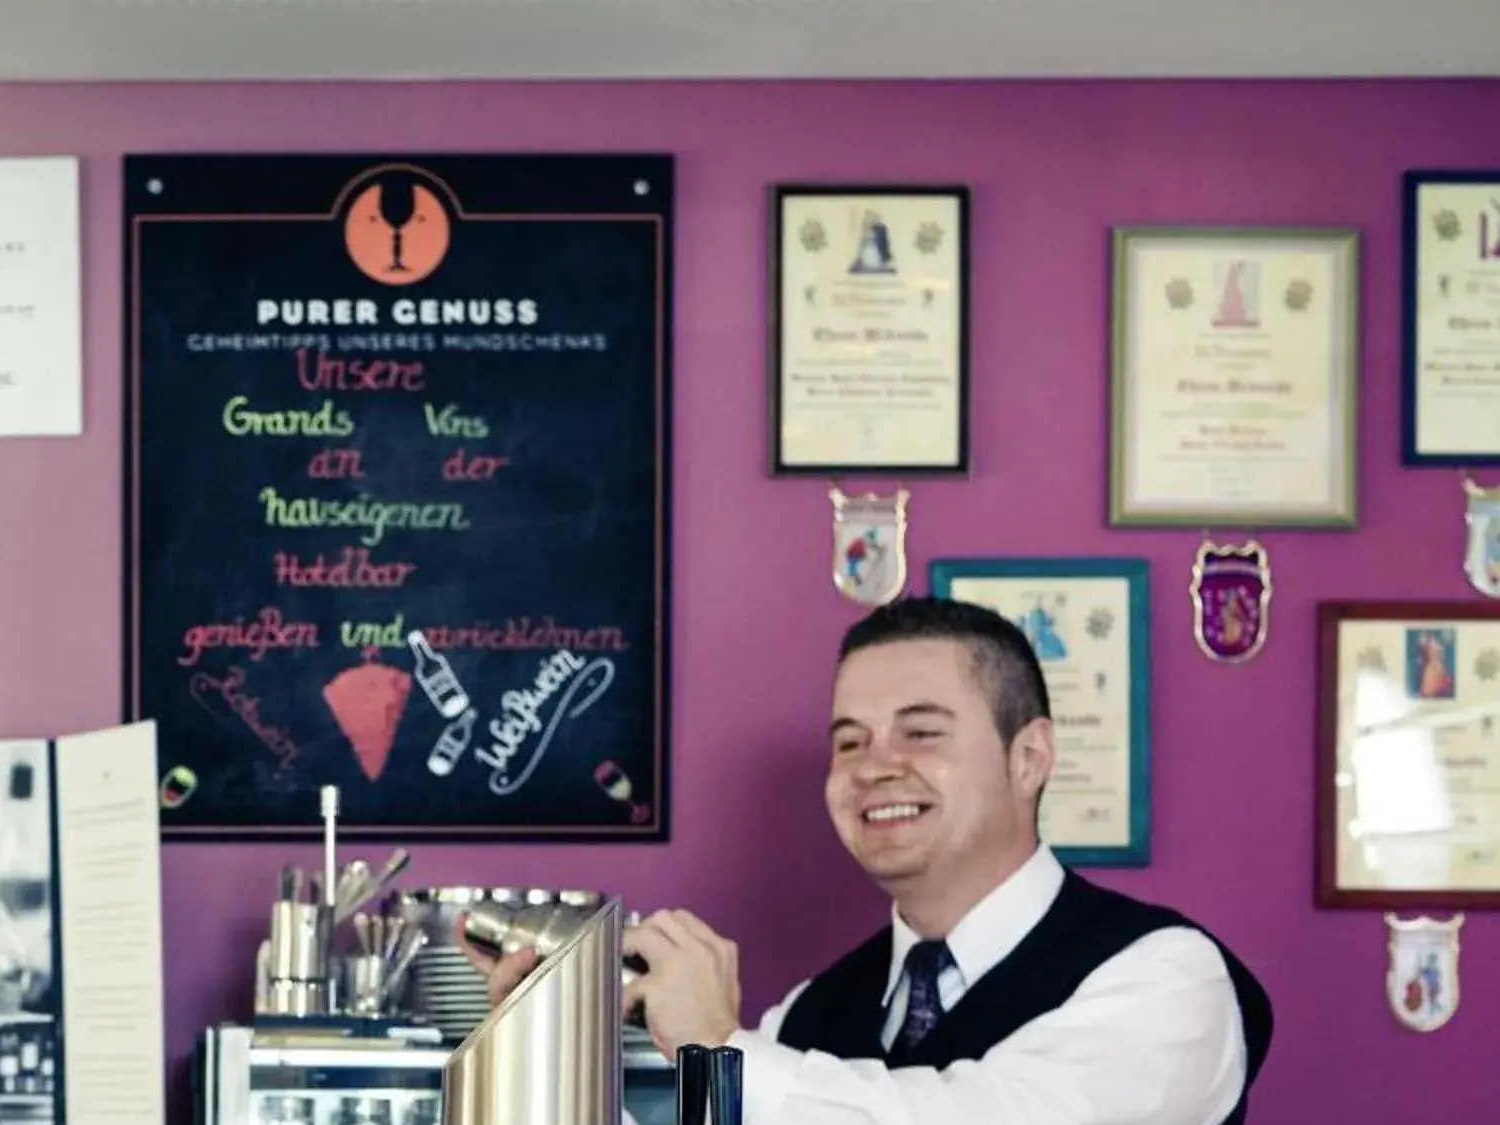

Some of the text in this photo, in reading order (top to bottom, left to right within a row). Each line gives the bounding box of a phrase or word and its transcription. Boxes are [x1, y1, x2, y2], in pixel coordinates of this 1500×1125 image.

[257, 298, 538, 325] PURER GENUSS
[337, 333, 435, 351] UNSERES
[296, 347, 425, 391] Unsere
[222, 396, 354, 436] Grands
[308, 448, 509, 480] an der
[274, 545, 417, 587] Hotelbar
[177, 606, 320, 666] genießen
[341, 613, 405, 648] und
